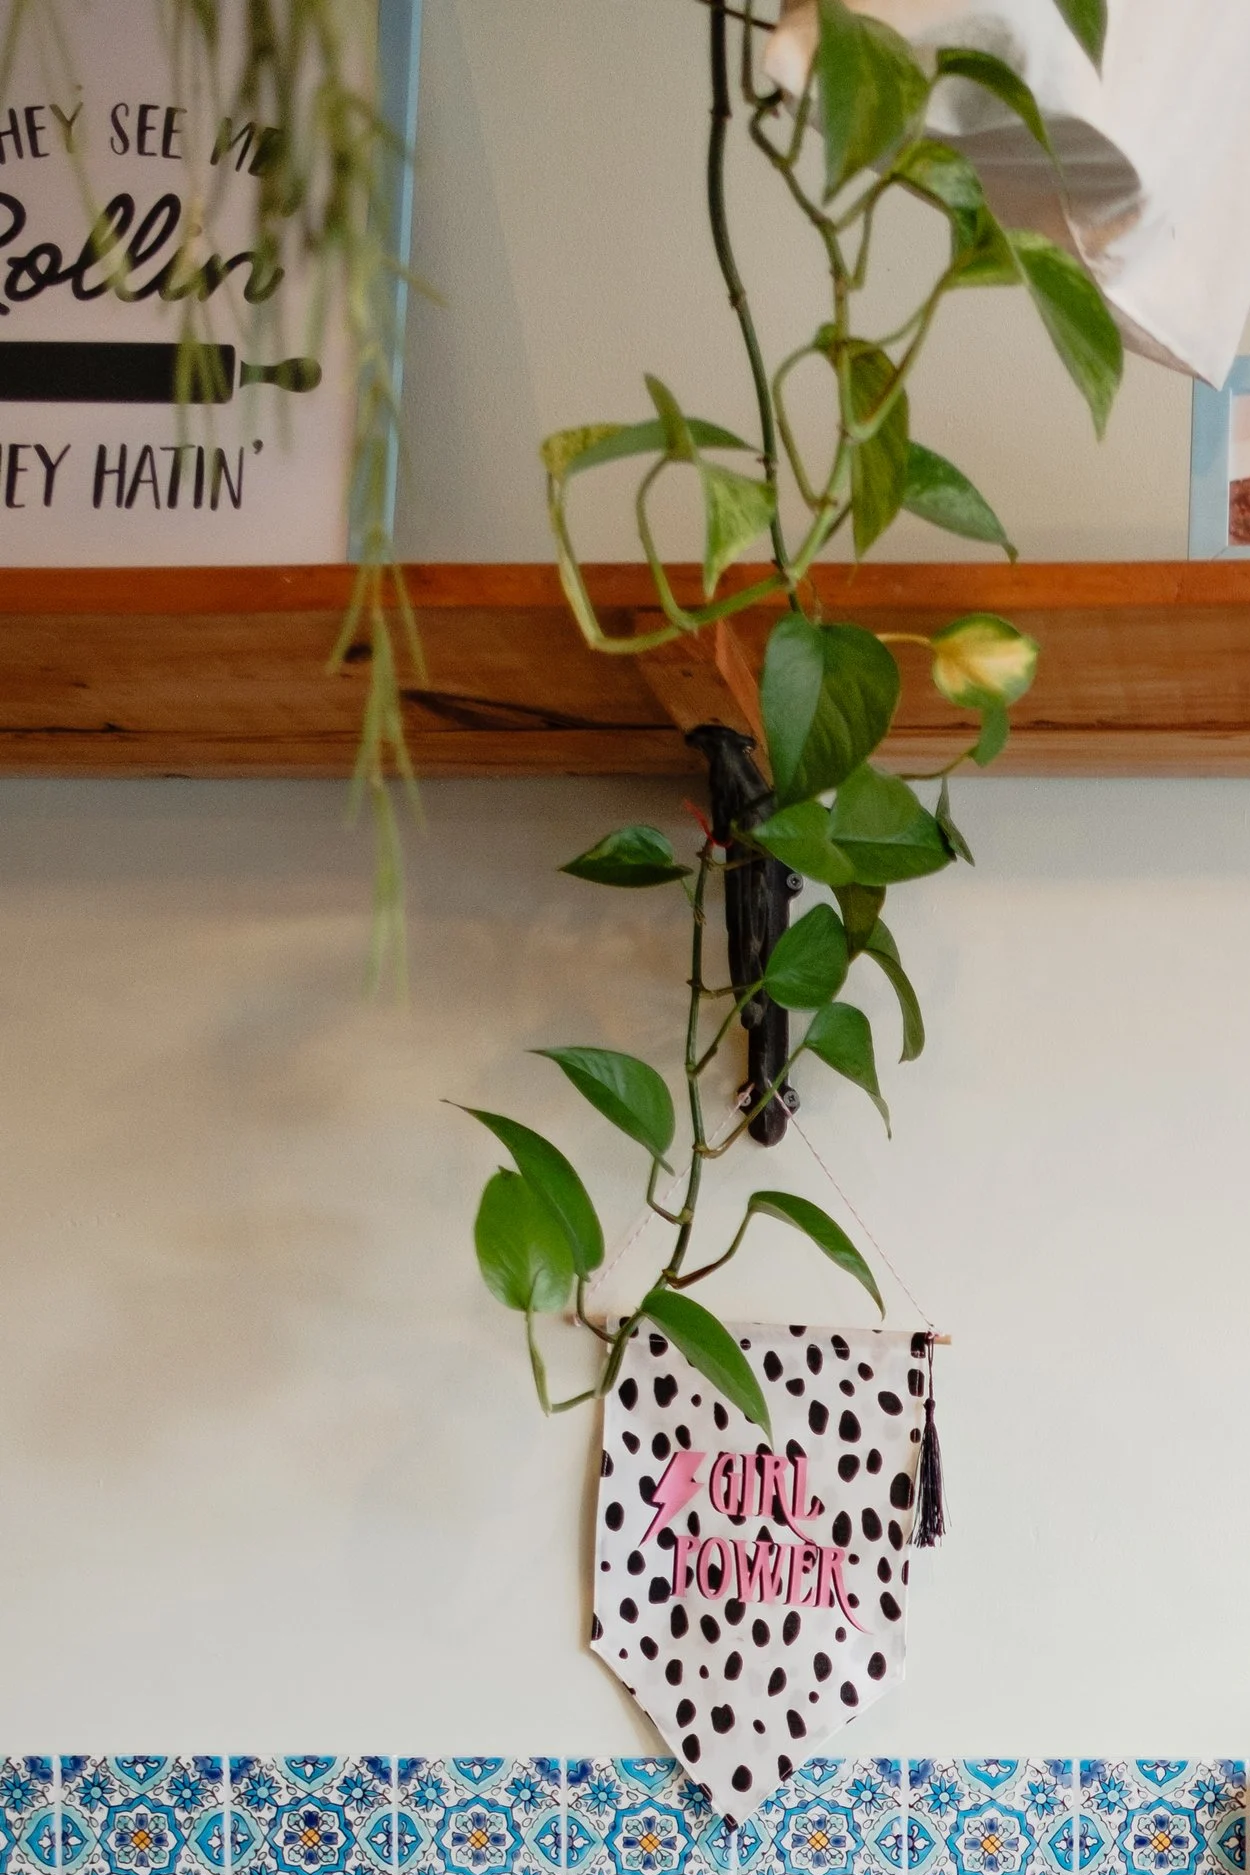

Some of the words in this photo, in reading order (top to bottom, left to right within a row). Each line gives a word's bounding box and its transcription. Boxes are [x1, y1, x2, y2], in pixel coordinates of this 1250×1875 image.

[110, 103, 186, 159] SEE
[93, 440, 264, 511] HATIN'
[708, 1450, 824, 1543] GIRL
[672, 1534, 873, 1635] POWER
